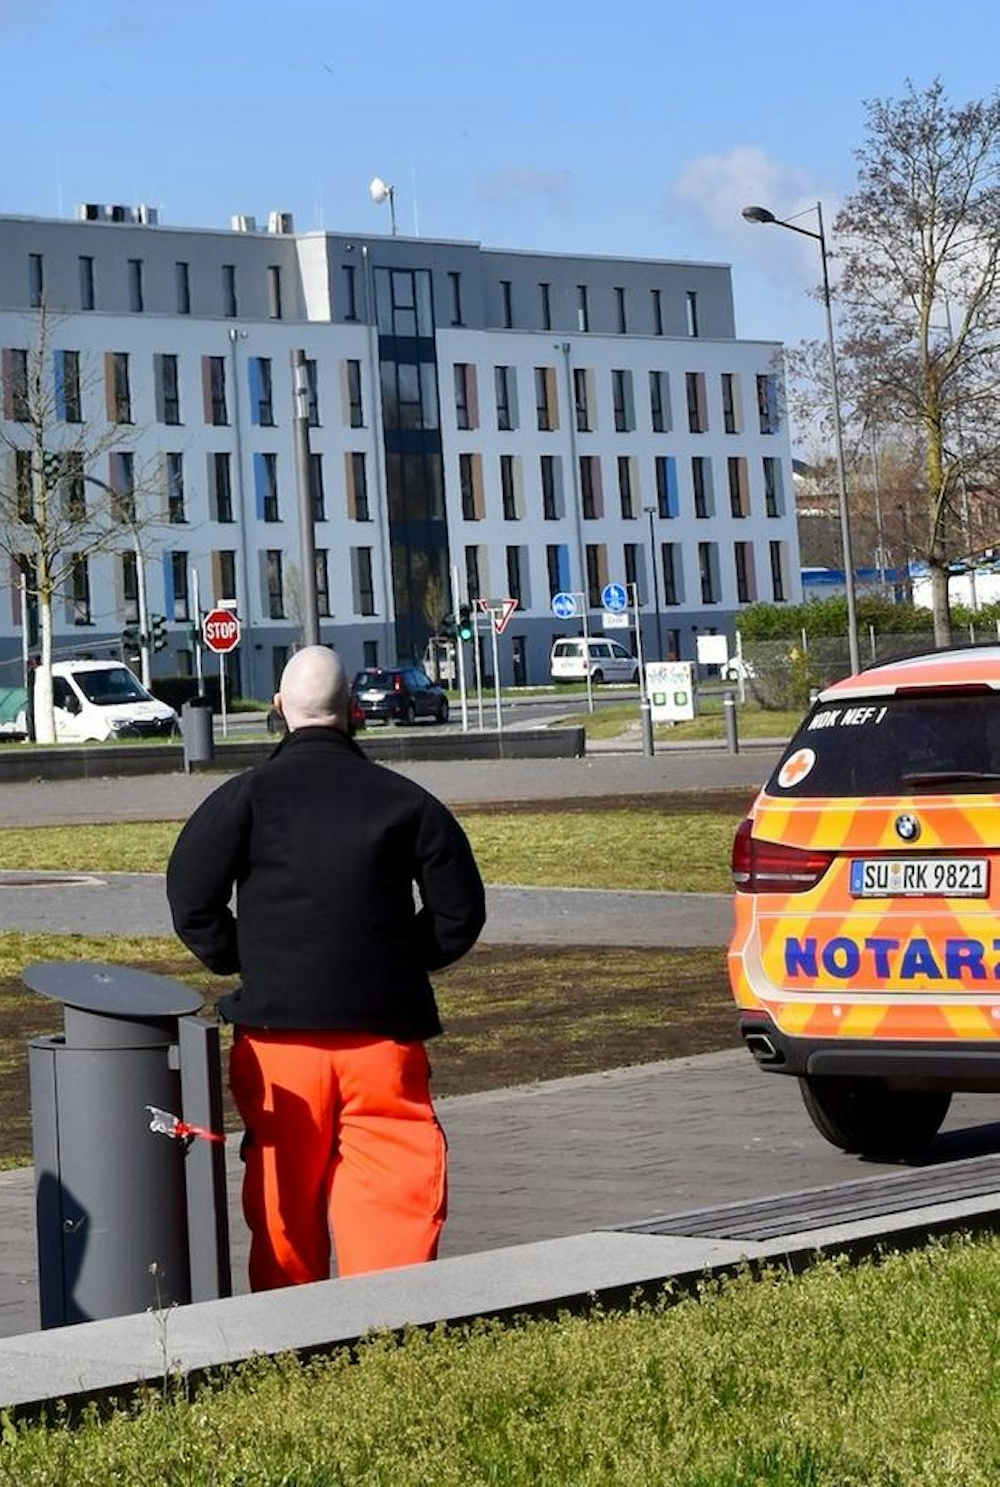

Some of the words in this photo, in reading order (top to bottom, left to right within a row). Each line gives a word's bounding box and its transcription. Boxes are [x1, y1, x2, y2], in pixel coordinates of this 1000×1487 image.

[207, 622, 236, 640] STOP
[840, 707, 877, 726] NEF
[865, 865, 888, 888] SU
[904, 865, 928, 888] RK
[934, 864, 983, 888] 9821
[785, 937, 1000, 980] NOTAR
